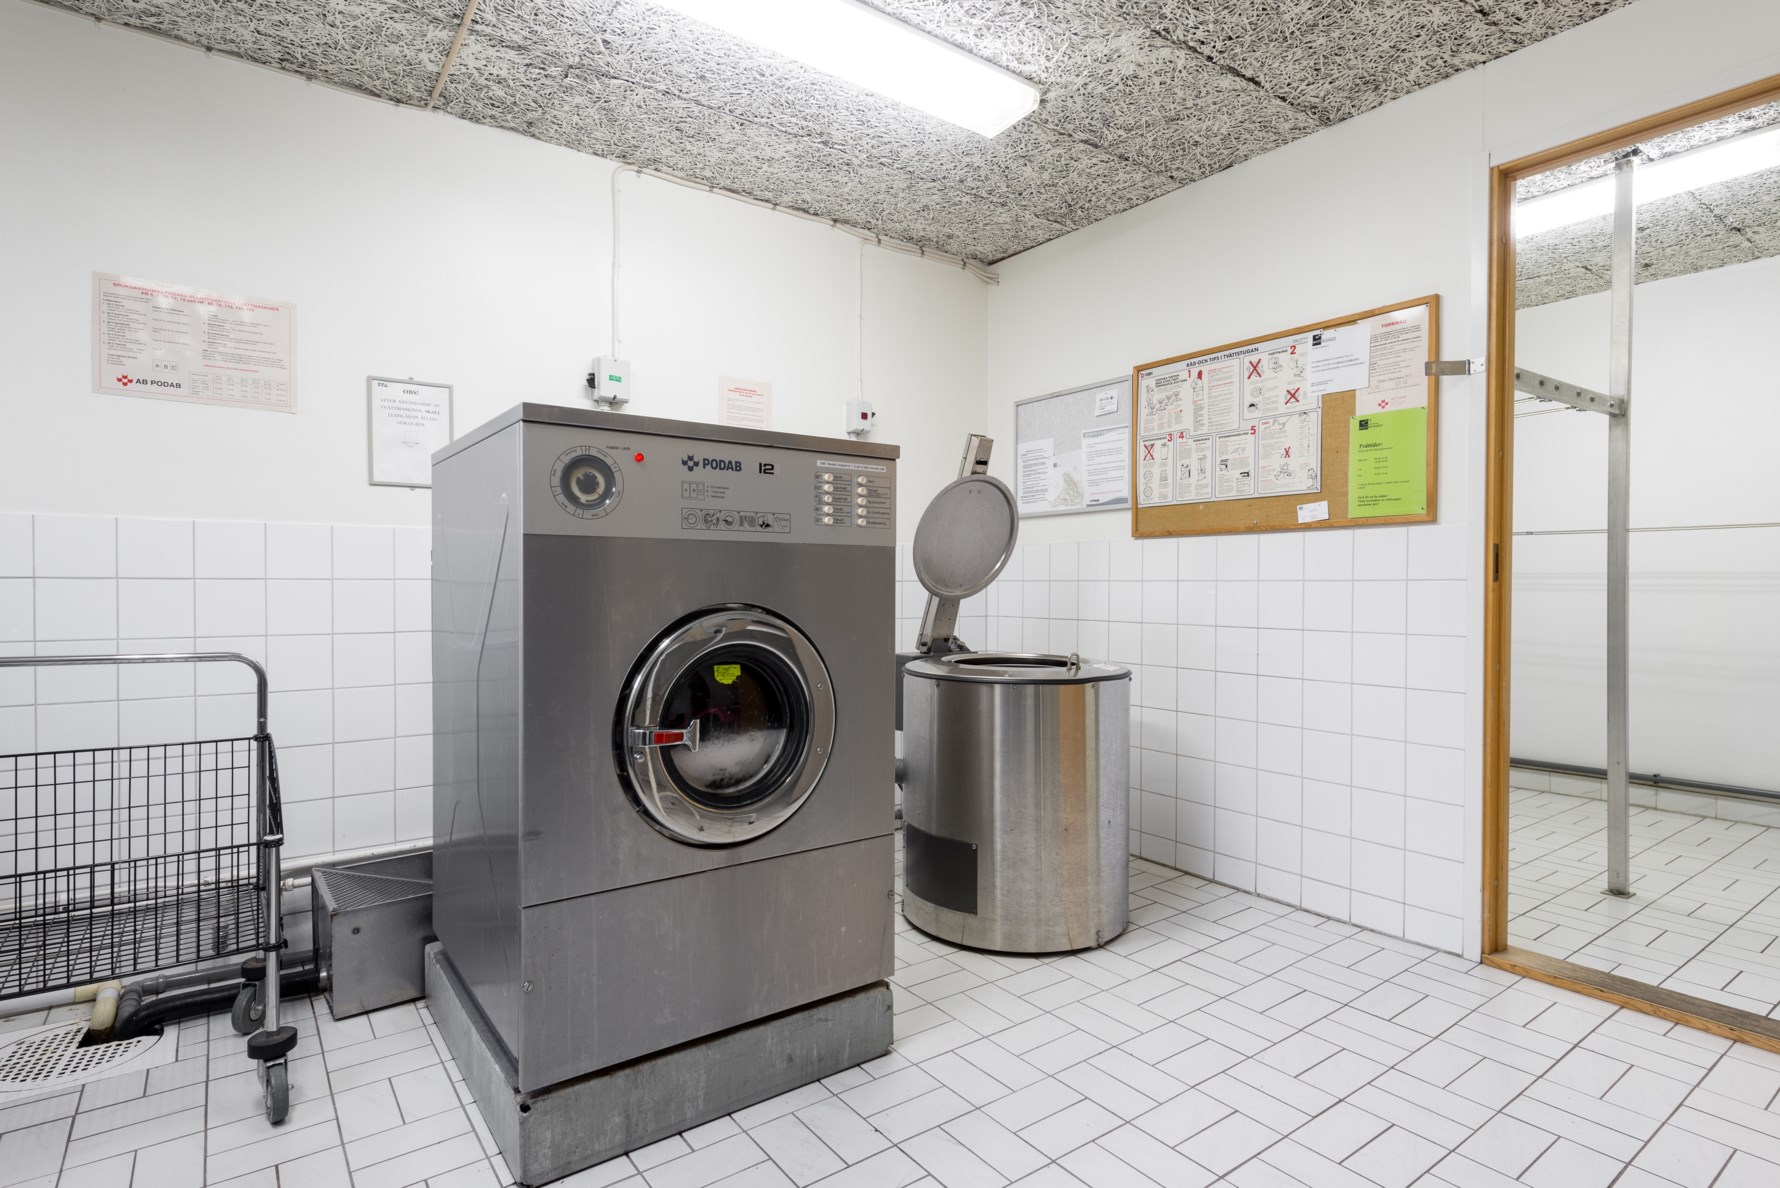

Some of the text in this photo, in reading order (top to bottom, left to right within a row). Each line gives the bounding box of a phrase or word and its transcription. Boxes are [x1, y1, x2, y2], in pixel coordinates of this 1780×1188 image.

[1223, 347, 1259, 359] TVÄTTSTUGAN
[1290, 345, 1297, 355] 2
[1188, 370, 1191, 378] 1
[150, 380, 182, 389] PODAB
[1250, 425, 1256, 435] 5
[1167, 433, 1172, 442] 3
[1178, 431, 1184, 440] 4
[702, 458, 742, 472] PODAB
[759, 462, 774, 474] 12
